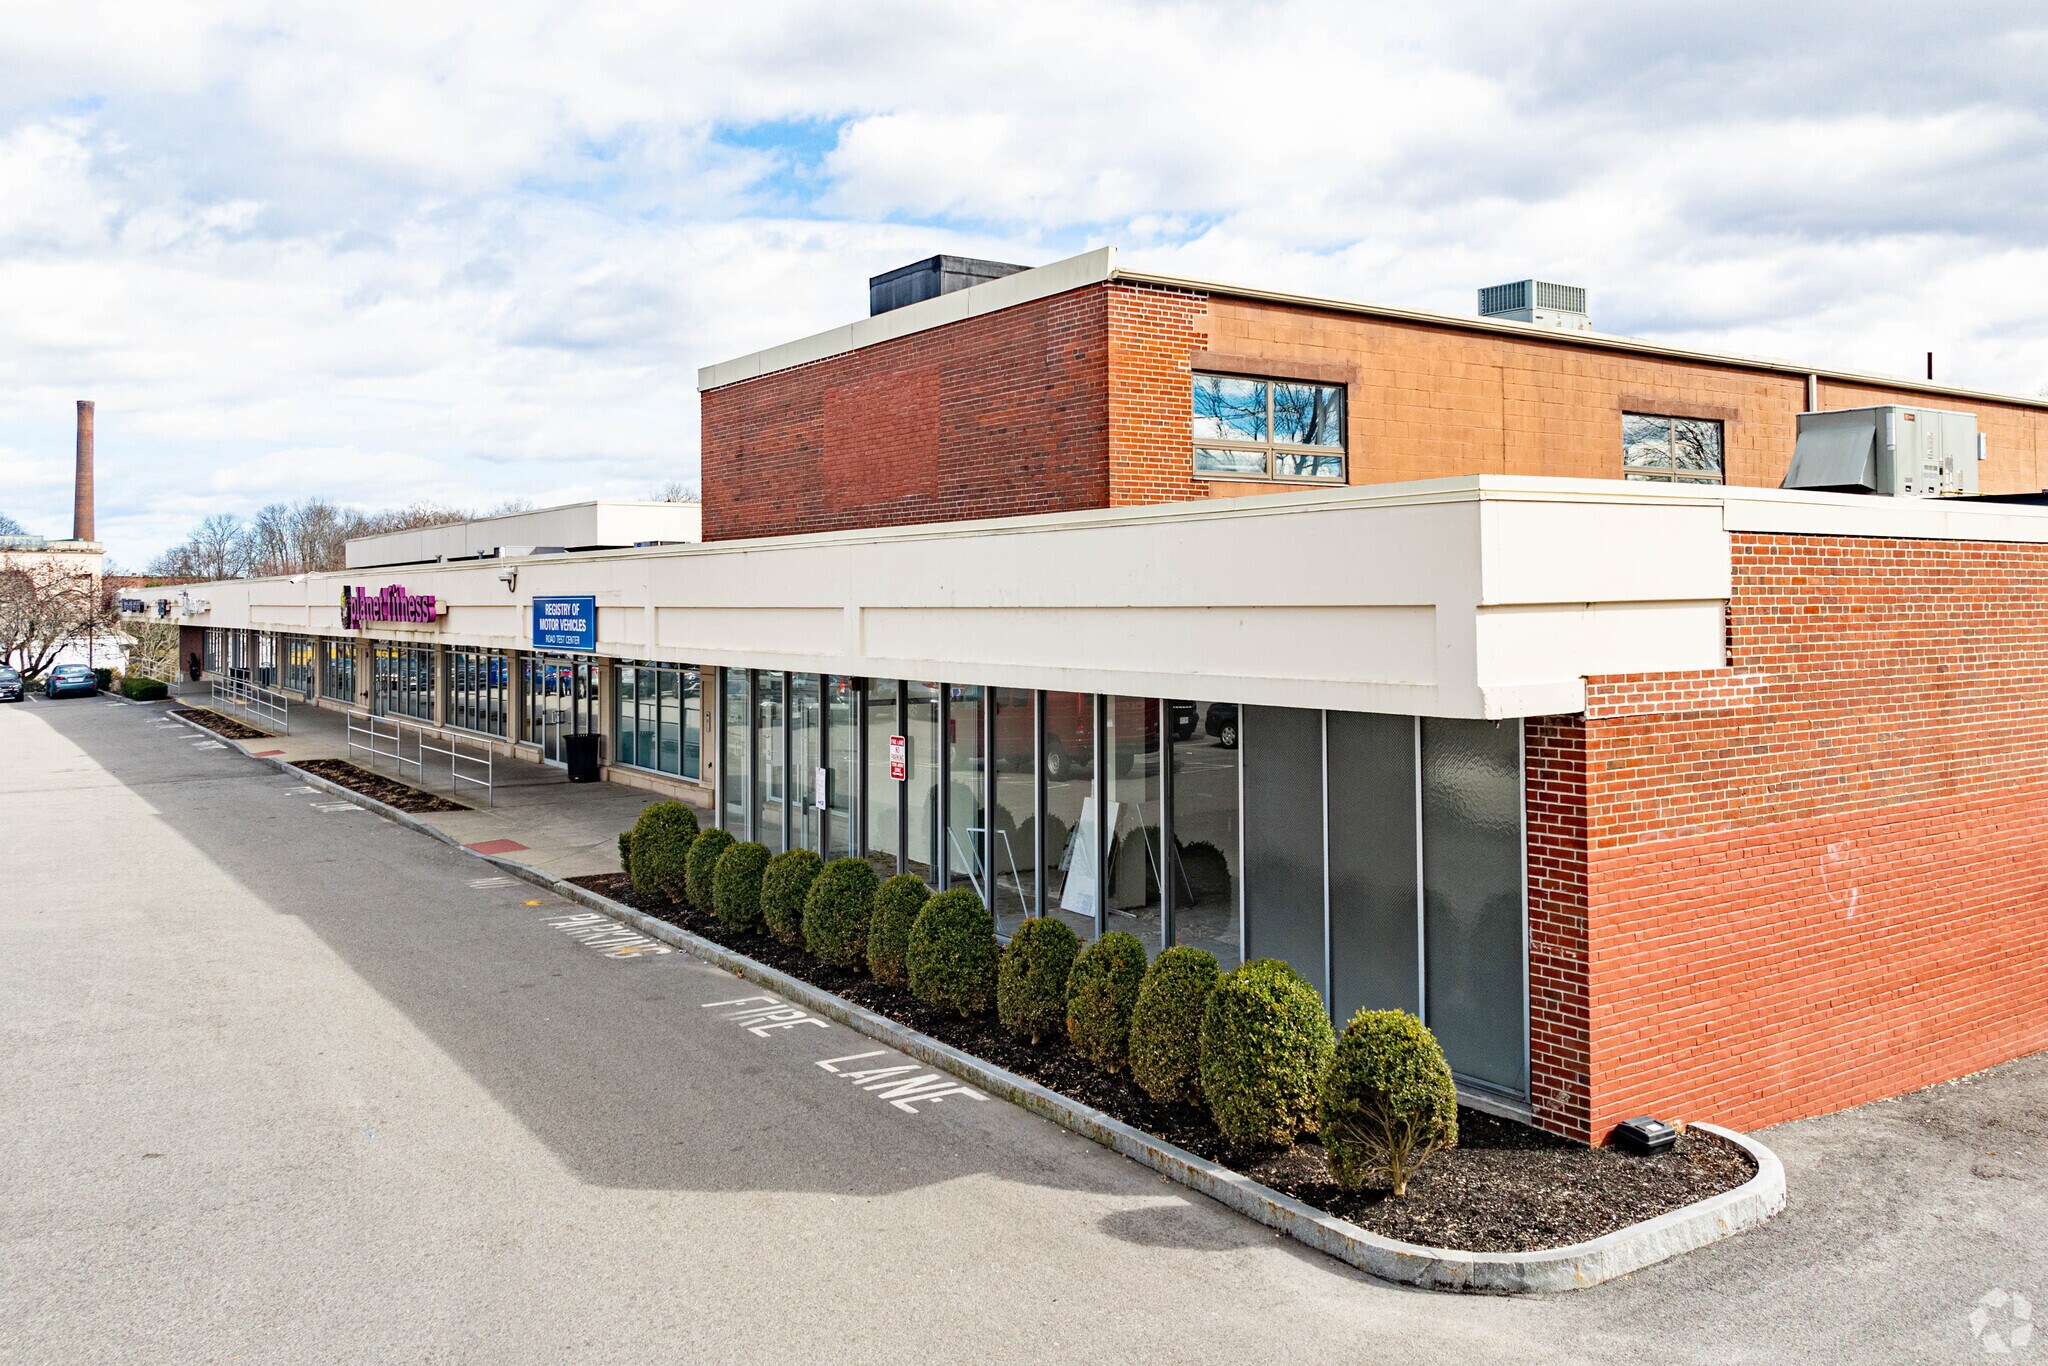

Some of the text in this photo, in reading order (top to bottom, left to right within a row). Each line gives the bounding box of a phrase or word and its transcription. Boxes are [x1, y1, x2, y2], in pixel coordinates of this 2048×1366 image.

[350, 585, 434, 629] planet fitness
[539, 618, 587, 633] MOTOR VEHICLES
[545, 603, 580, 616] REGISTRY OF
[545, 635, 580, 645] ROAD TEST CENTER
[539, 912, 672, 959] PARKING
[701, 996, 830, 1038] FIRE
[815, 1050, 991, 1114] LANE
